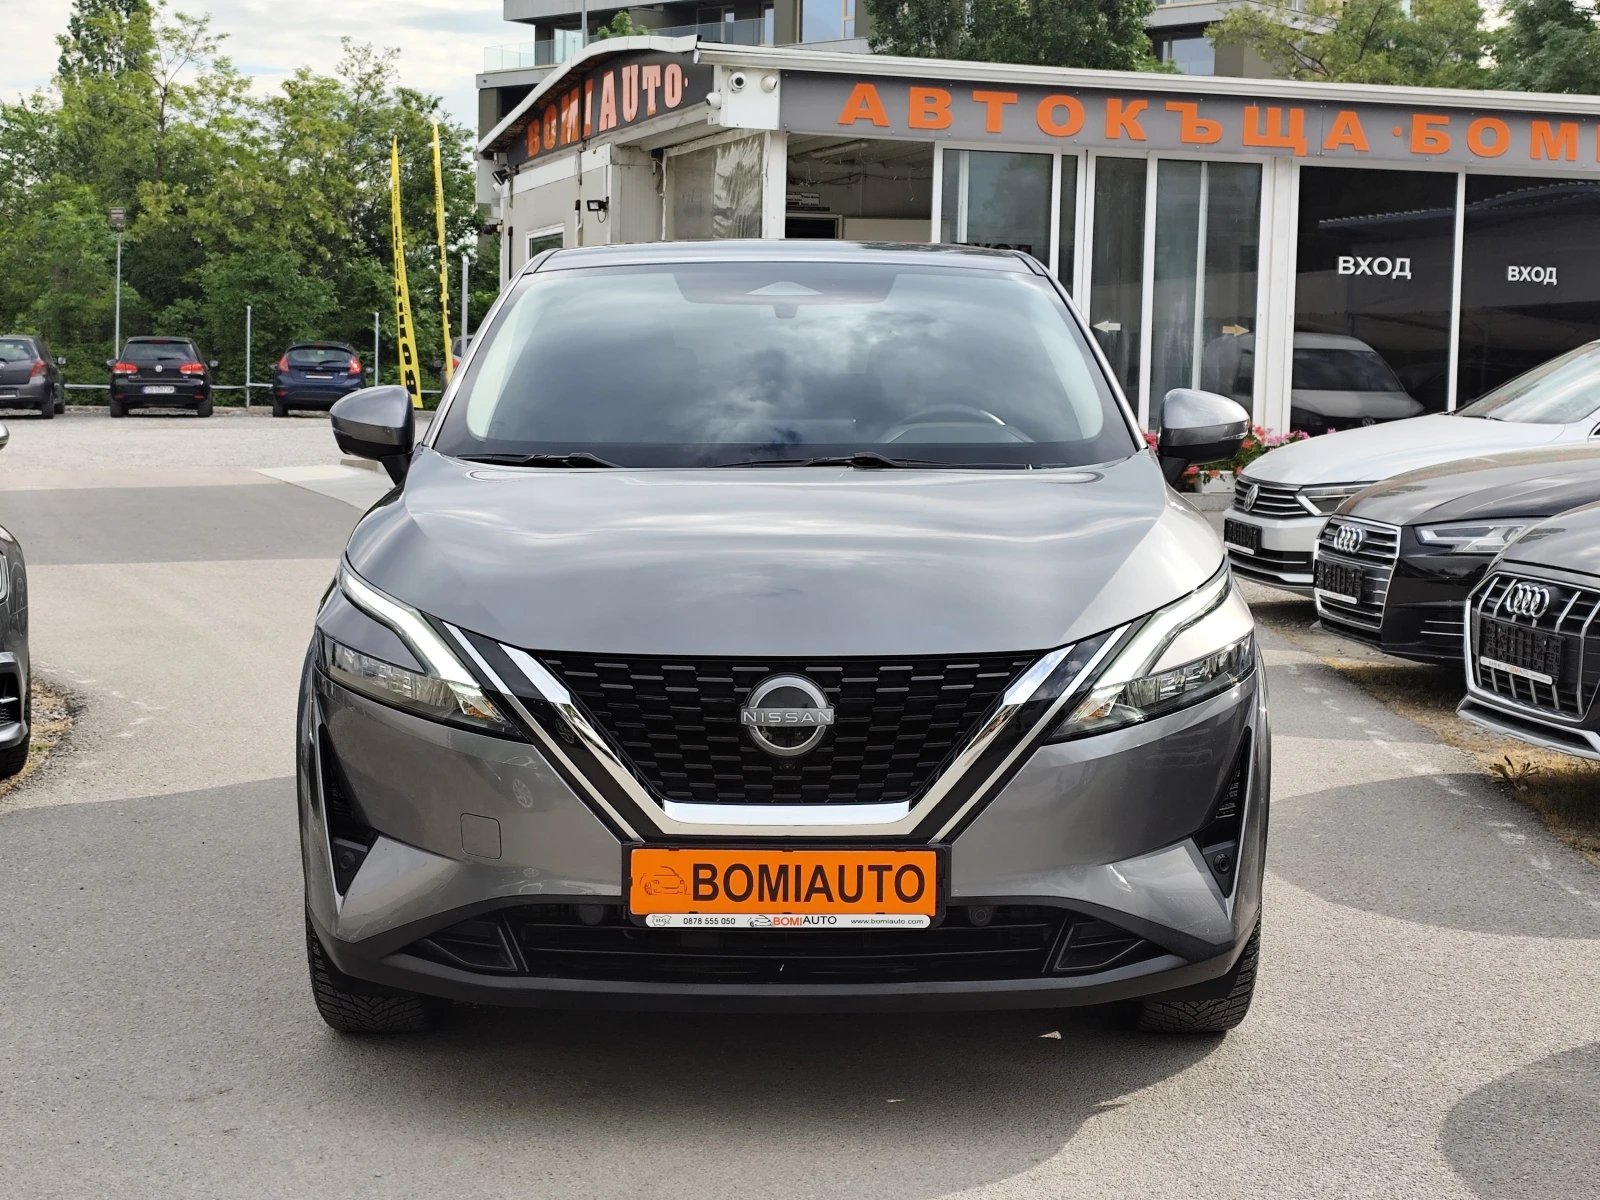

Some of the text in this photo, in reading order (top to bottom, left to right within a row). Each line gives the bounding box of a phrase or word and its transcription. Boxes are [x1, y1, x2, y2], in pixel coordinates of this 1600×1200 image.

[837, 83, 1600, 162] АВТОКЪЩА БОМ
[1337, 256, 1412, 280] ВХОД
[1507, 265, 1558, 286] ВХОД
[743, 711, 831, 723] NISSAN
[692, 863, 926, 904] BOMIAUTO
[683, 917, 736, 925] 0878 555 050
[772, 915, 838, 927] BOMIAUTO
